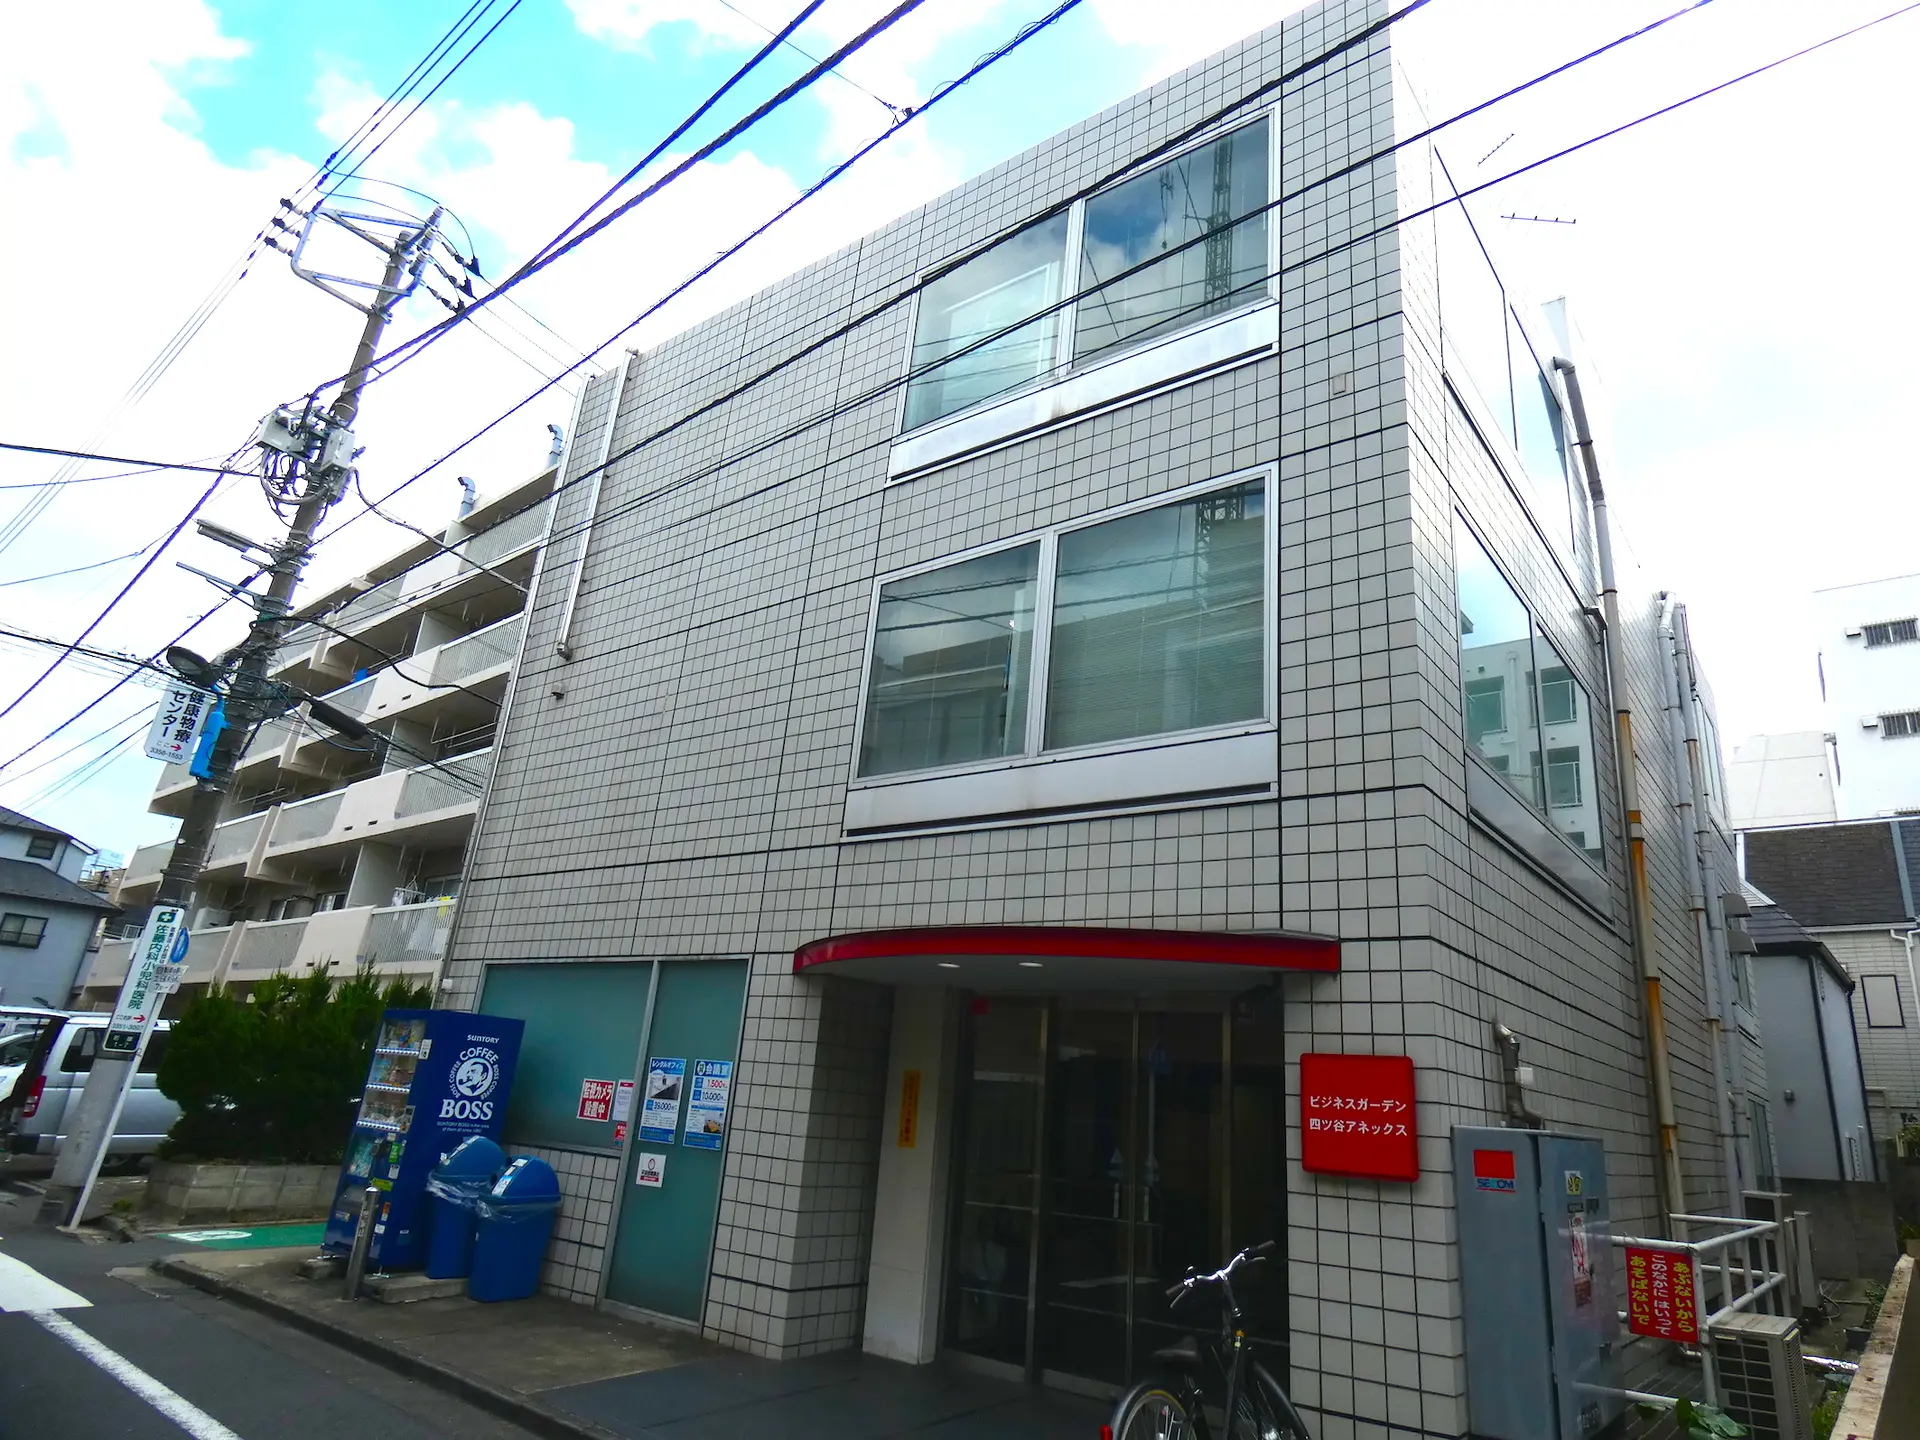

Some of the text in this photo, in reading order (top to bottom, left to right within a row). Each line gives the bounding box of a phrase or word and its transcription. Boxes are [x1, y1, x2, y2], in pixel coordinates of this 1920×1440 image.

[162, 690, 186, 737] センター
[127, 924, 170, 1010] 佐藤内科小児科医院
[467, 1034, 500, 1044] SUNTORY
[459, 1047, 499, 1064] COFFEE
[652, 1060, 684, 1070] レンタルオフィス
[706, 1063, 728, 1076] 会議室
[583, 1082, 613, 1100] 監視カメラ
[439, 1099, 494, 1121] BOSS
[583, 1100, 606, 1118] 設置中
[1310, 1096, 1407, 1112] ビジネスガーデン
[1309, 1118, 1408, 1136] 四ツ谷アネックス
[1630, 1255, 1650, 1326] あそばないで
[1651, 1254, 1673, 1335] このなかに はいって
[1673, 1262, 1694, 1333] あぶないから
